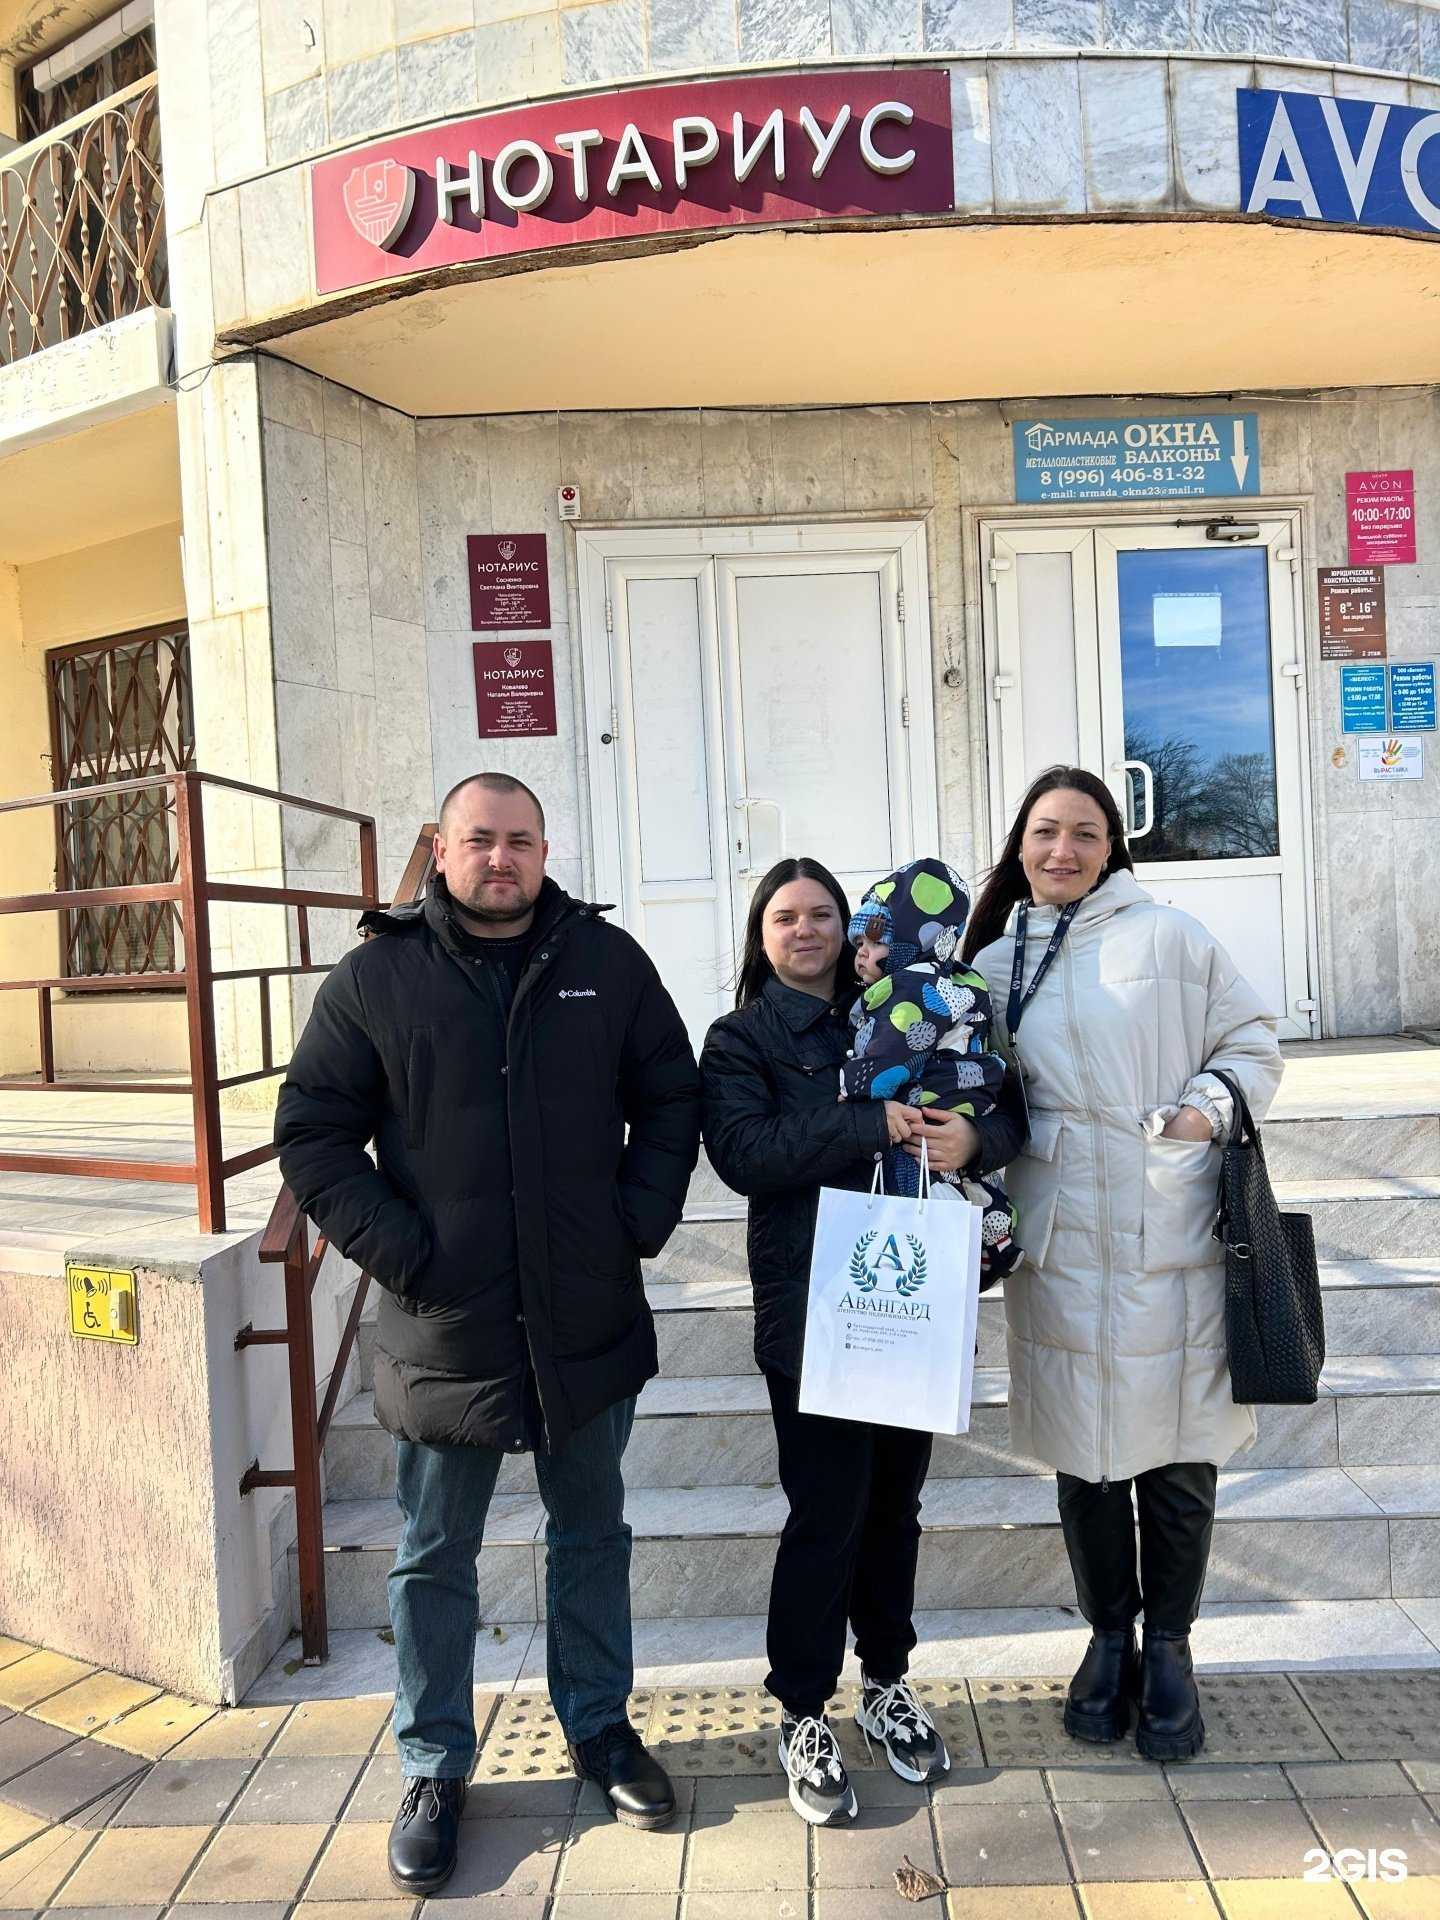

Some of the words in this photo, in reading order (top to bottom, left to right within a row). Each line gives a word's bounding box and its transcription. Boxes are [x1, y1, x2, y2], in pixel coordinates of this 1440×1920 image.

[435, 101, 916, 225] НОТАРИУС
[1043, 430, 1119, 448] АРМАДА
[1124, 422, 1220, 447] ОКНА
[1026, 456, 1117, 468] МЕТАЛЛОПЛАСТИКОВЫЕ
[1125, 448, 1221, 464] БАЛКОНЫ
[1041, 471, 1051, 485] 8
[1058, 470, 1104, 488] (996)
[1111, 467, 1205, 482] 406-81-32
[1360, 480, 1402, 490] AVON
[1041, 490, 1076, 499] e-mail:
[1352, 507, 1411, 521] 10:00-17:00
[478, 562, 539, 573] НОТАРИУС
[483, 669, 545, 680] НОТАРИУС
[567, 989, 597, 997] Columbia
